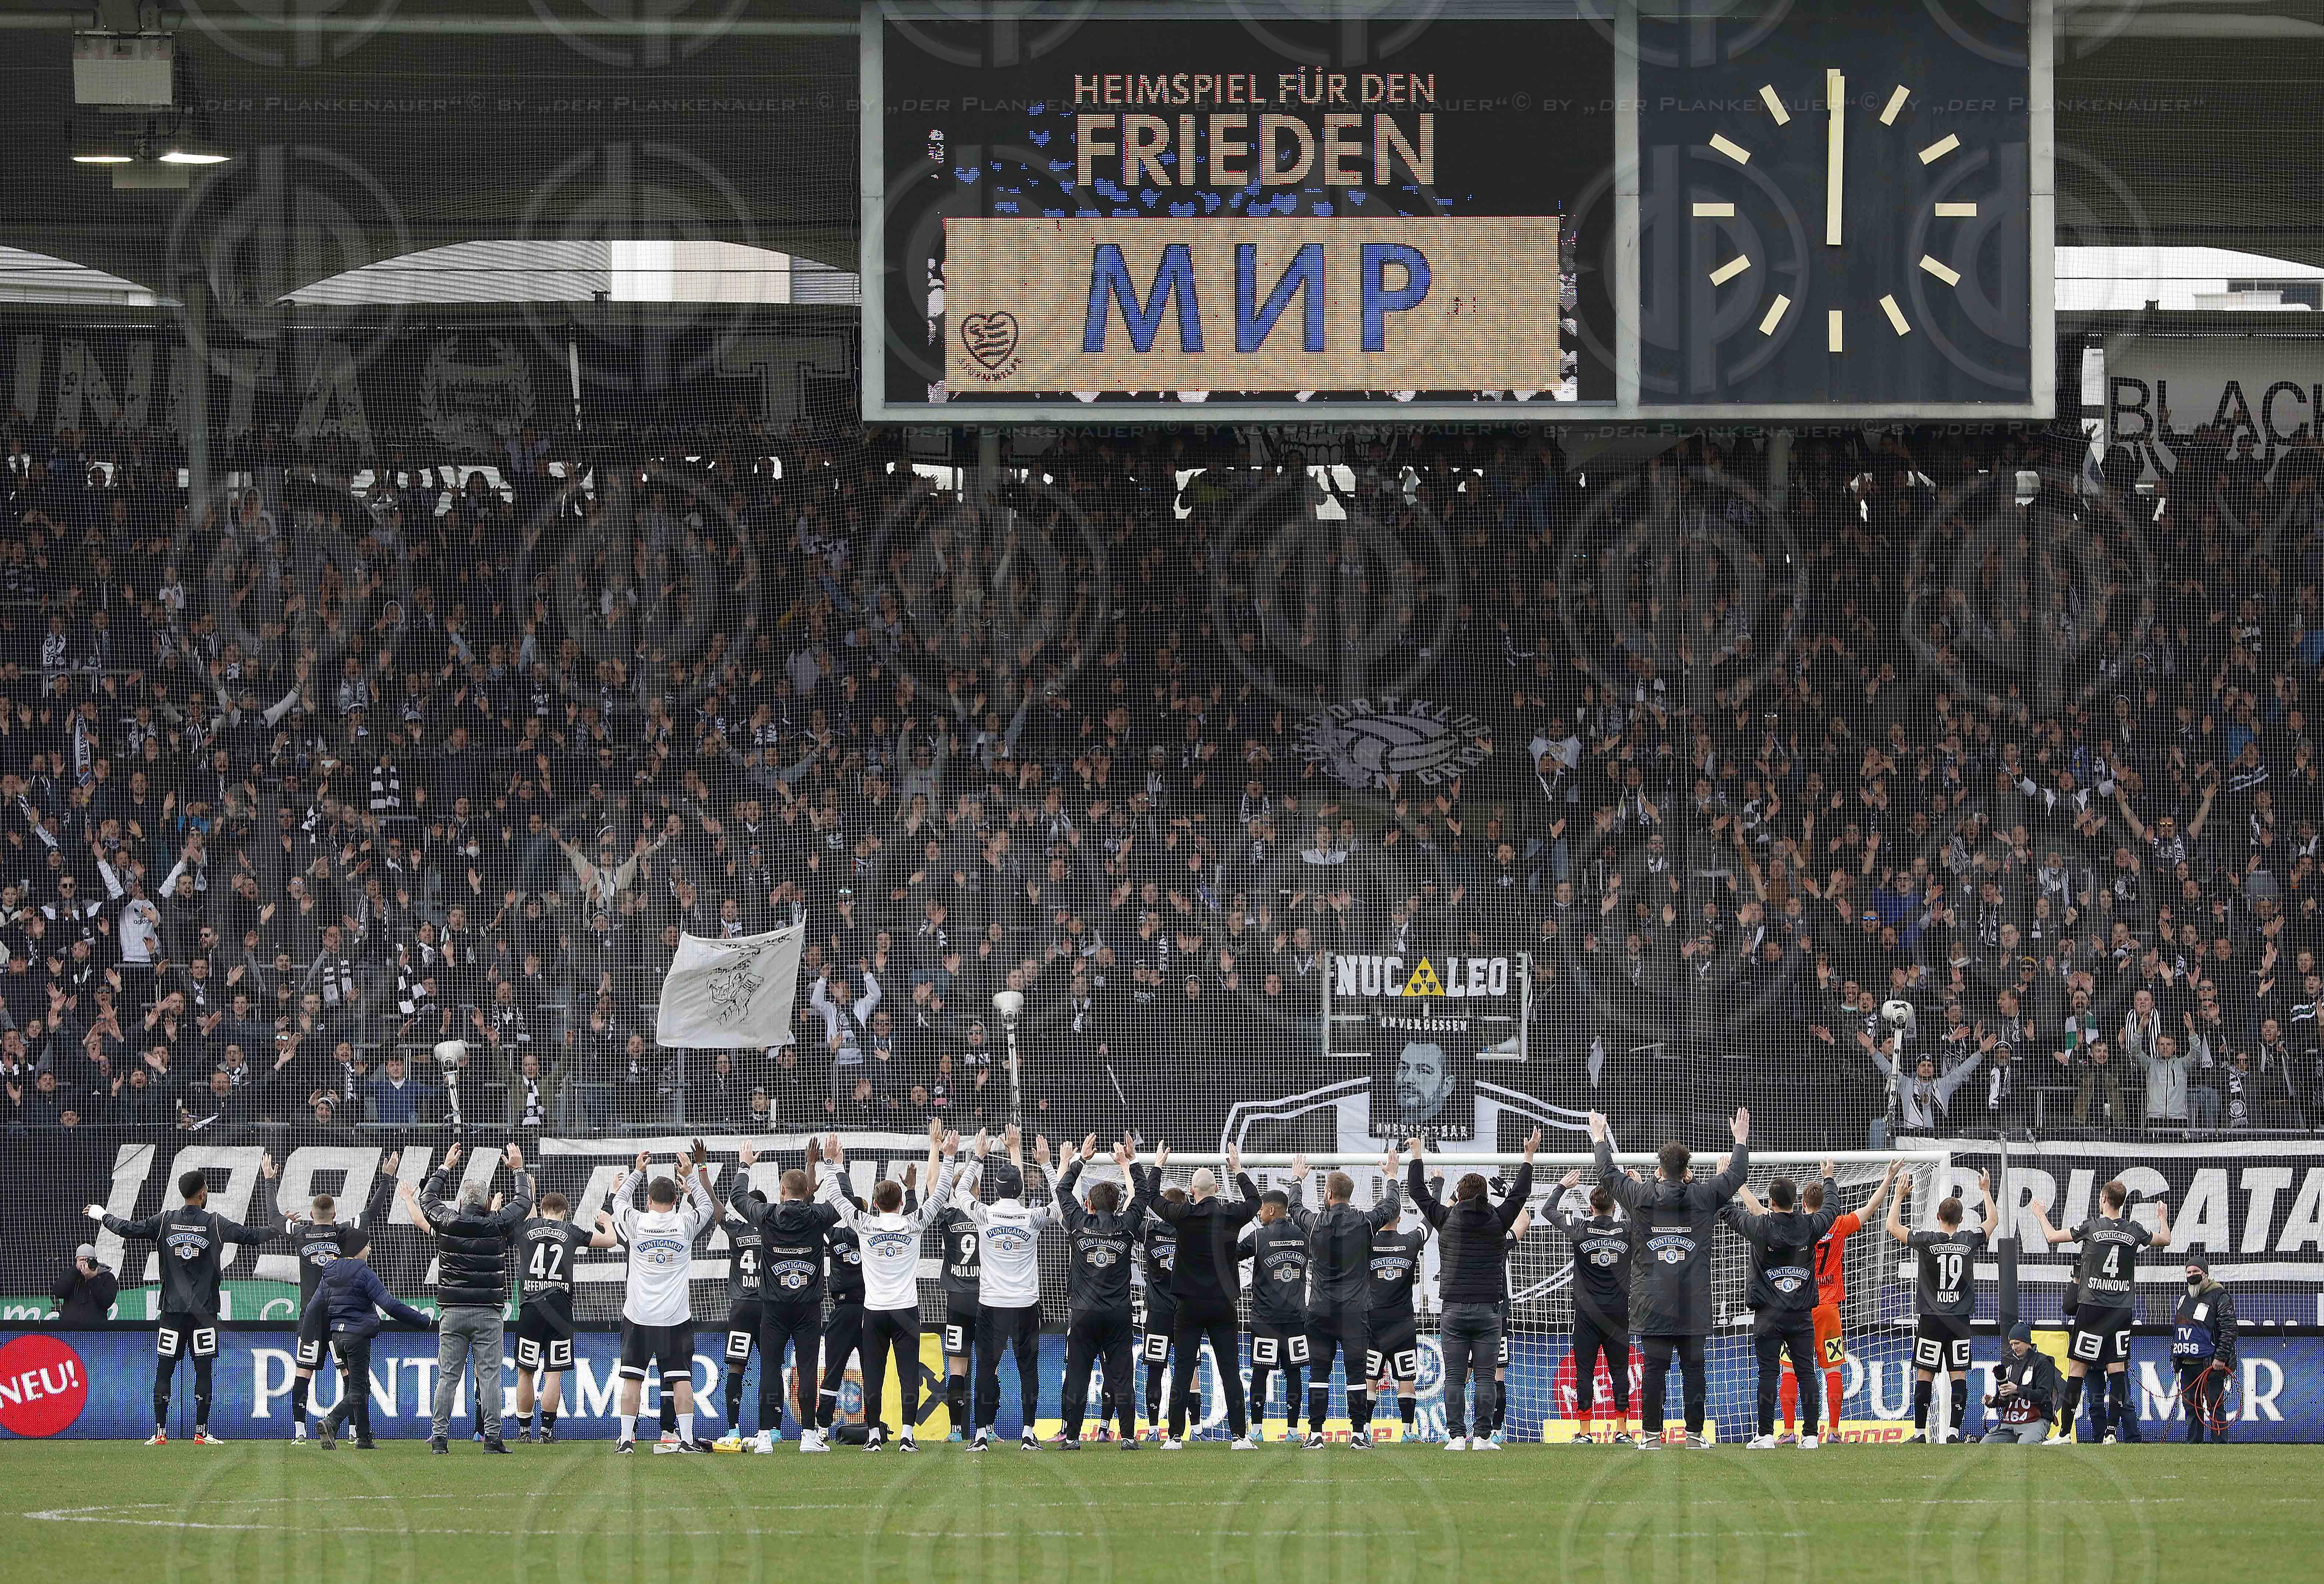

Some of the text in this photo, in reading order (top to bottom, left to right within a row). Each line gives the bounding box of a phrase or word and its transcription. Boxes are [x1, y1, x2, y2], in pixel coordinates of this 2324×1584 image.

[1075, 66, 1436, 104] HEIMSPIEL FÜR DEN
[1076, 113, 1435, 186] FRIEDEN
[1083, 244, 1431, 352] МИР
[2111, 378, 2324, 444] BLAC
[1381, 1016, 1468, 1032] UNVERGESSEN
[169, 1235, 209, 1248] PUNTIGAMER
[530, 1228, 567, 1241] PUNTIGAMER
[869, 1233, 911, 1246] PUNTIGAMER
[988, 1227, 1030, 1241] PUNTIGAMER
[2095, 1231, 2135, 1245] PUNTIGAMER
[639, 1239, 683, 1252] PUNTIGAMER
[960, 1234, 977, 1265] 9
[1079, 1238, 1126, 1253] PUNTIGAMER
[1581, 1239, 1627, 1253] PUNTIGAMER
[1648, 1236, 1695, 1251] PUNTIGAMER
[1931, 1244, 1971, 1254] PUNTIGAMER
[529, 1242, 564, 1281] 42
[773, 1260, 815, 1275] PUNTIGAMER
[1371, 1257, 1412, 1270] PUNTIGAMER
[2101, 1245, 2119, 1278] 4
[1766, 1267, 1810, 1280] PUNTIGAMER
[1937, 1254, 1963, 1290] 19
[2087, 1277, 2130, 1292] STANKOVIC
[1936, 1290, 1960, 1303] KUEN
[2178, 1327, 2192, 1340] TV
[2173, 1342, 2199, 1354] 2058
[0, 1360, 79, 1408] NEU!
